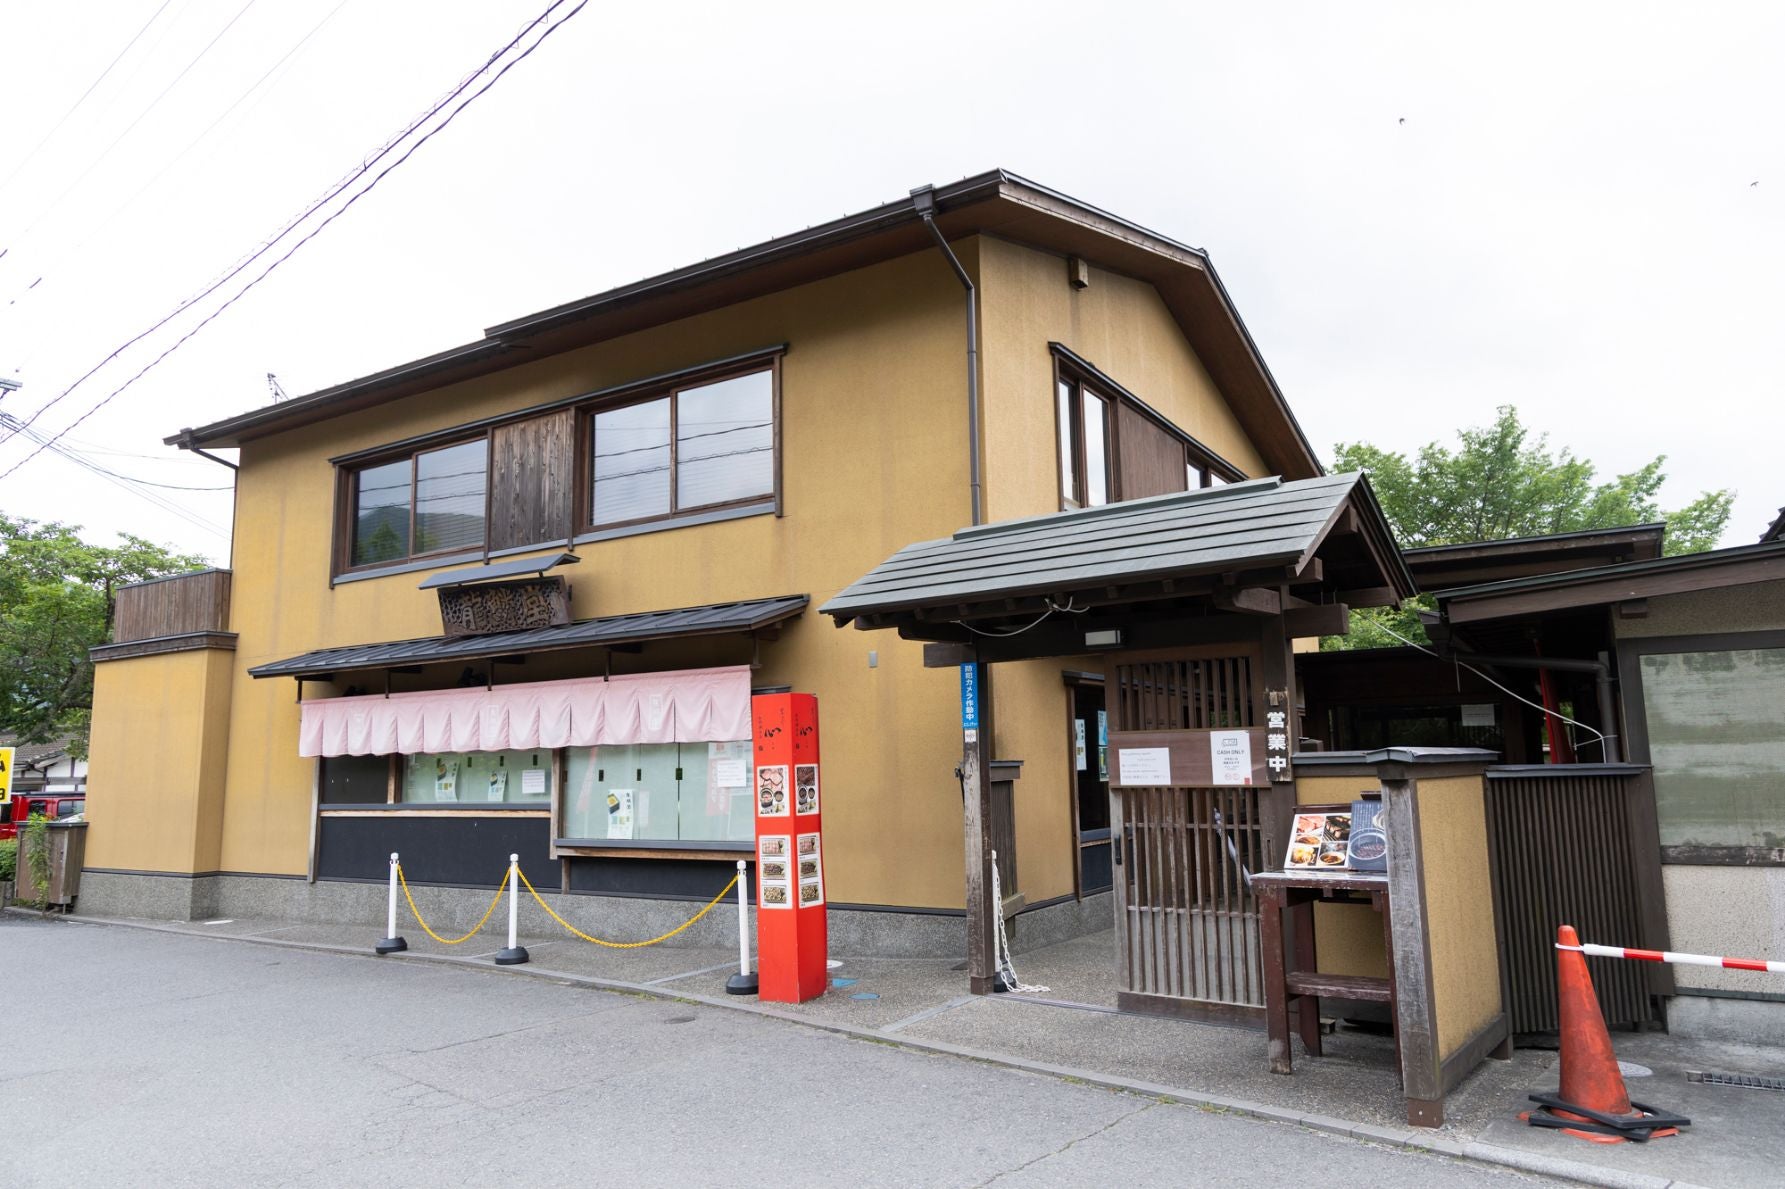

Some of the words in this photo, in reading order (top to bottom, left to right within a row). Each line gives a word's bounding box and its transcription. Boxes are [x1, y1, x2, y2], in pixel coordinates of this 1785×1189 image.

[964, 665, 975, 721] 防犯カメラ作動中
[1266, 711, 1287, 772] 営業中
